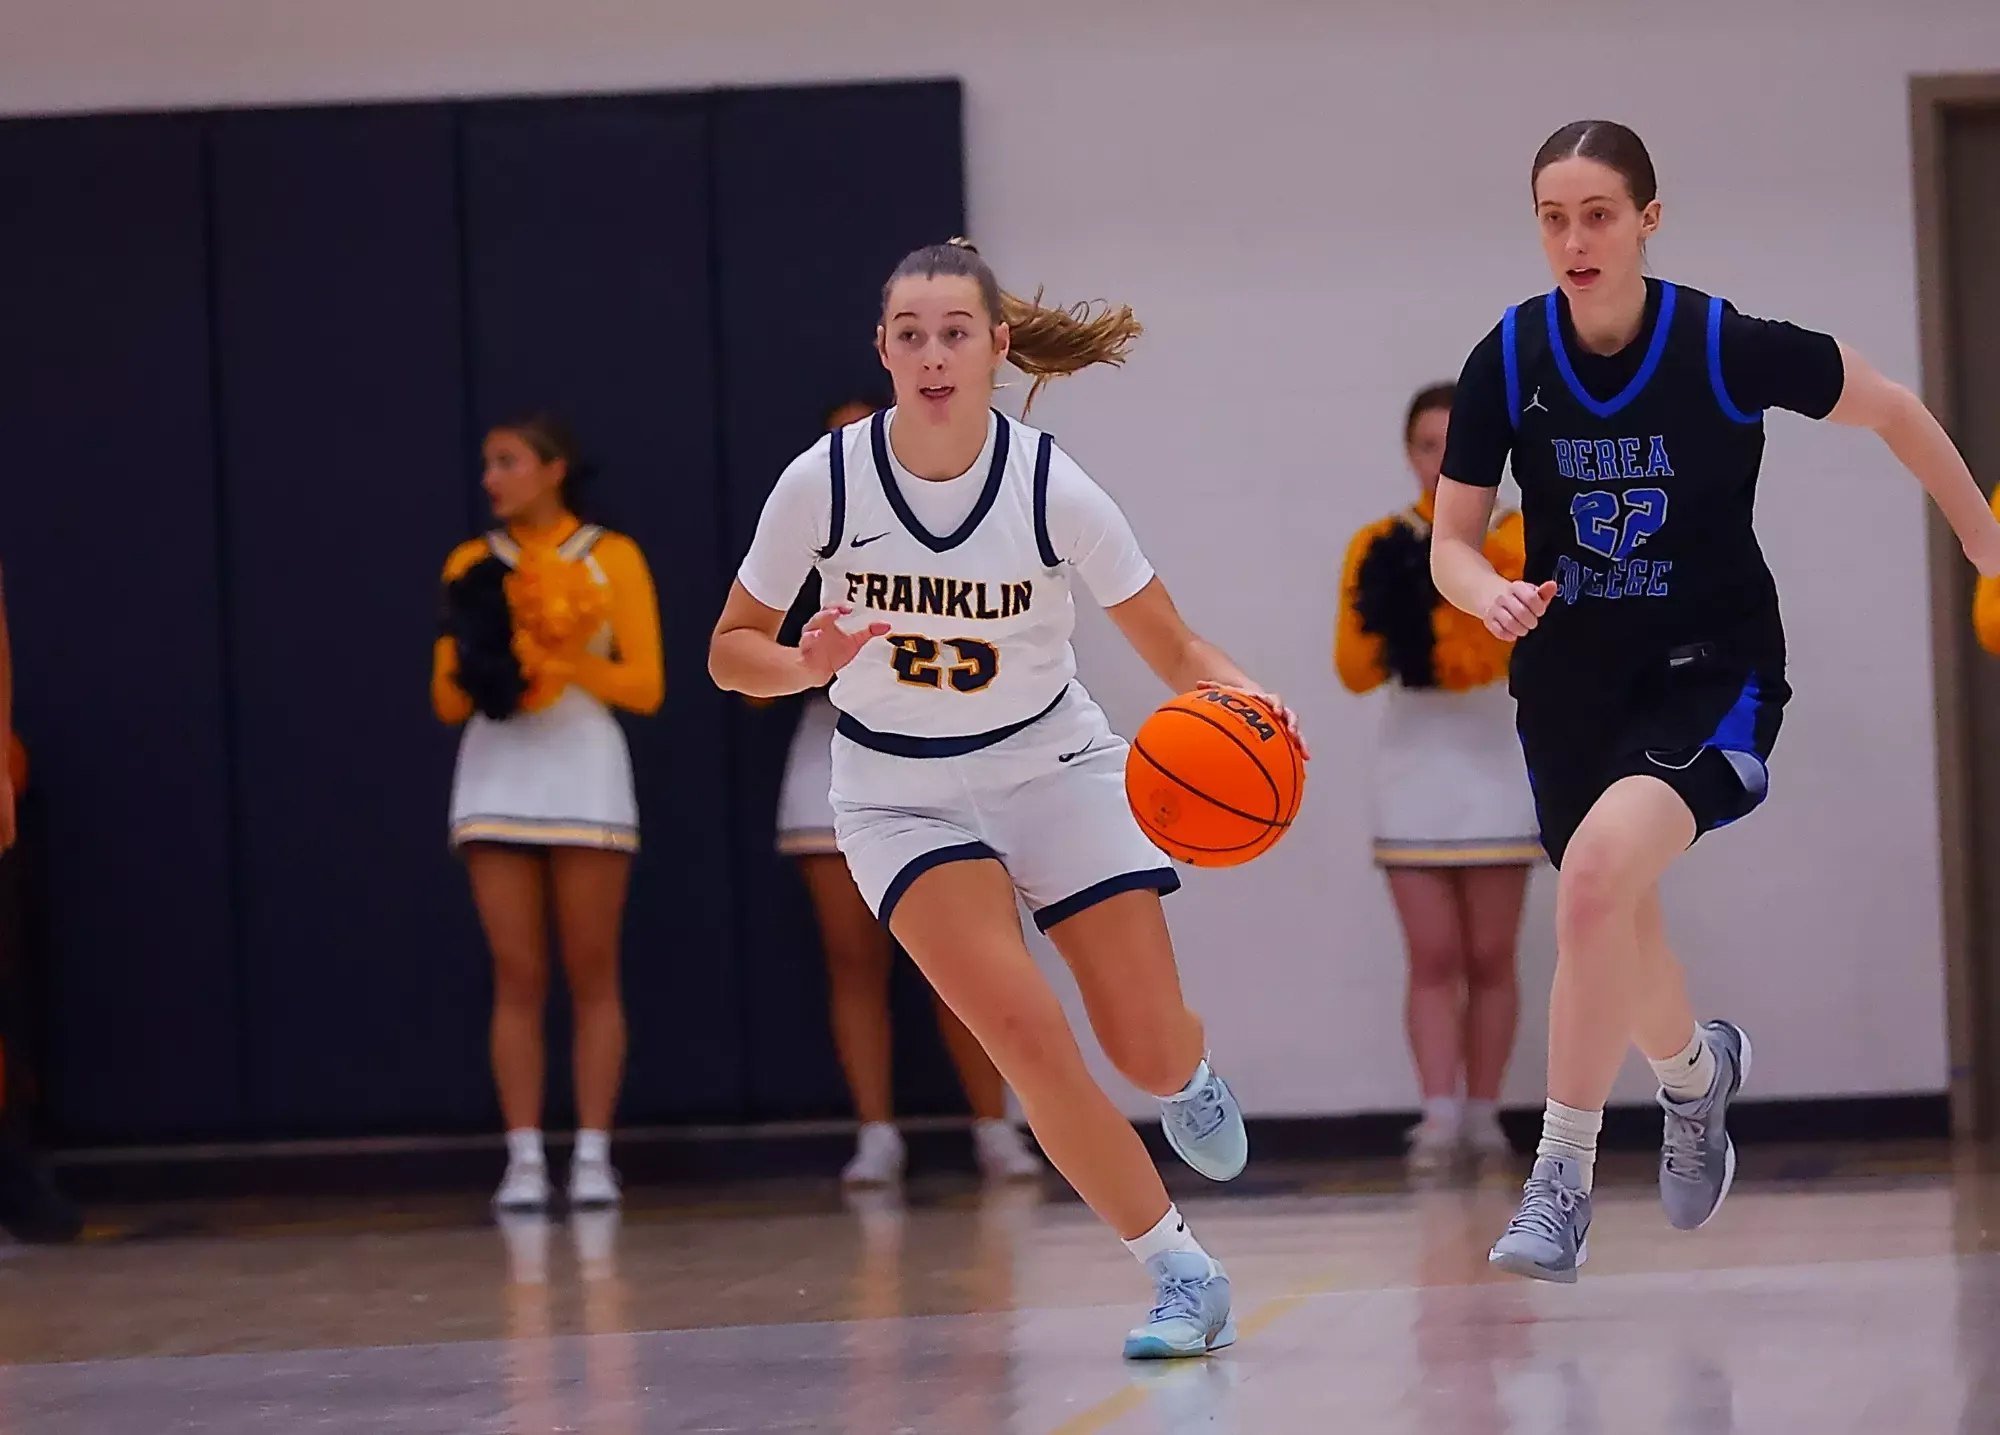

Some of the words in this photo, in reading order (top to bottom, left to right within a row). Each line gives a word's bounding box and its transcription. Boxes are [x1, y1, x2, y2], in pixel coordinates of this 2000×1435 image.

[1551, 435, 1674, 481] BEREA
[1570, 487, 1668, 561] 22
[845, 572, 1033, 620] FRANKLIN
[1196, 690, 1276, 742] NCAA
